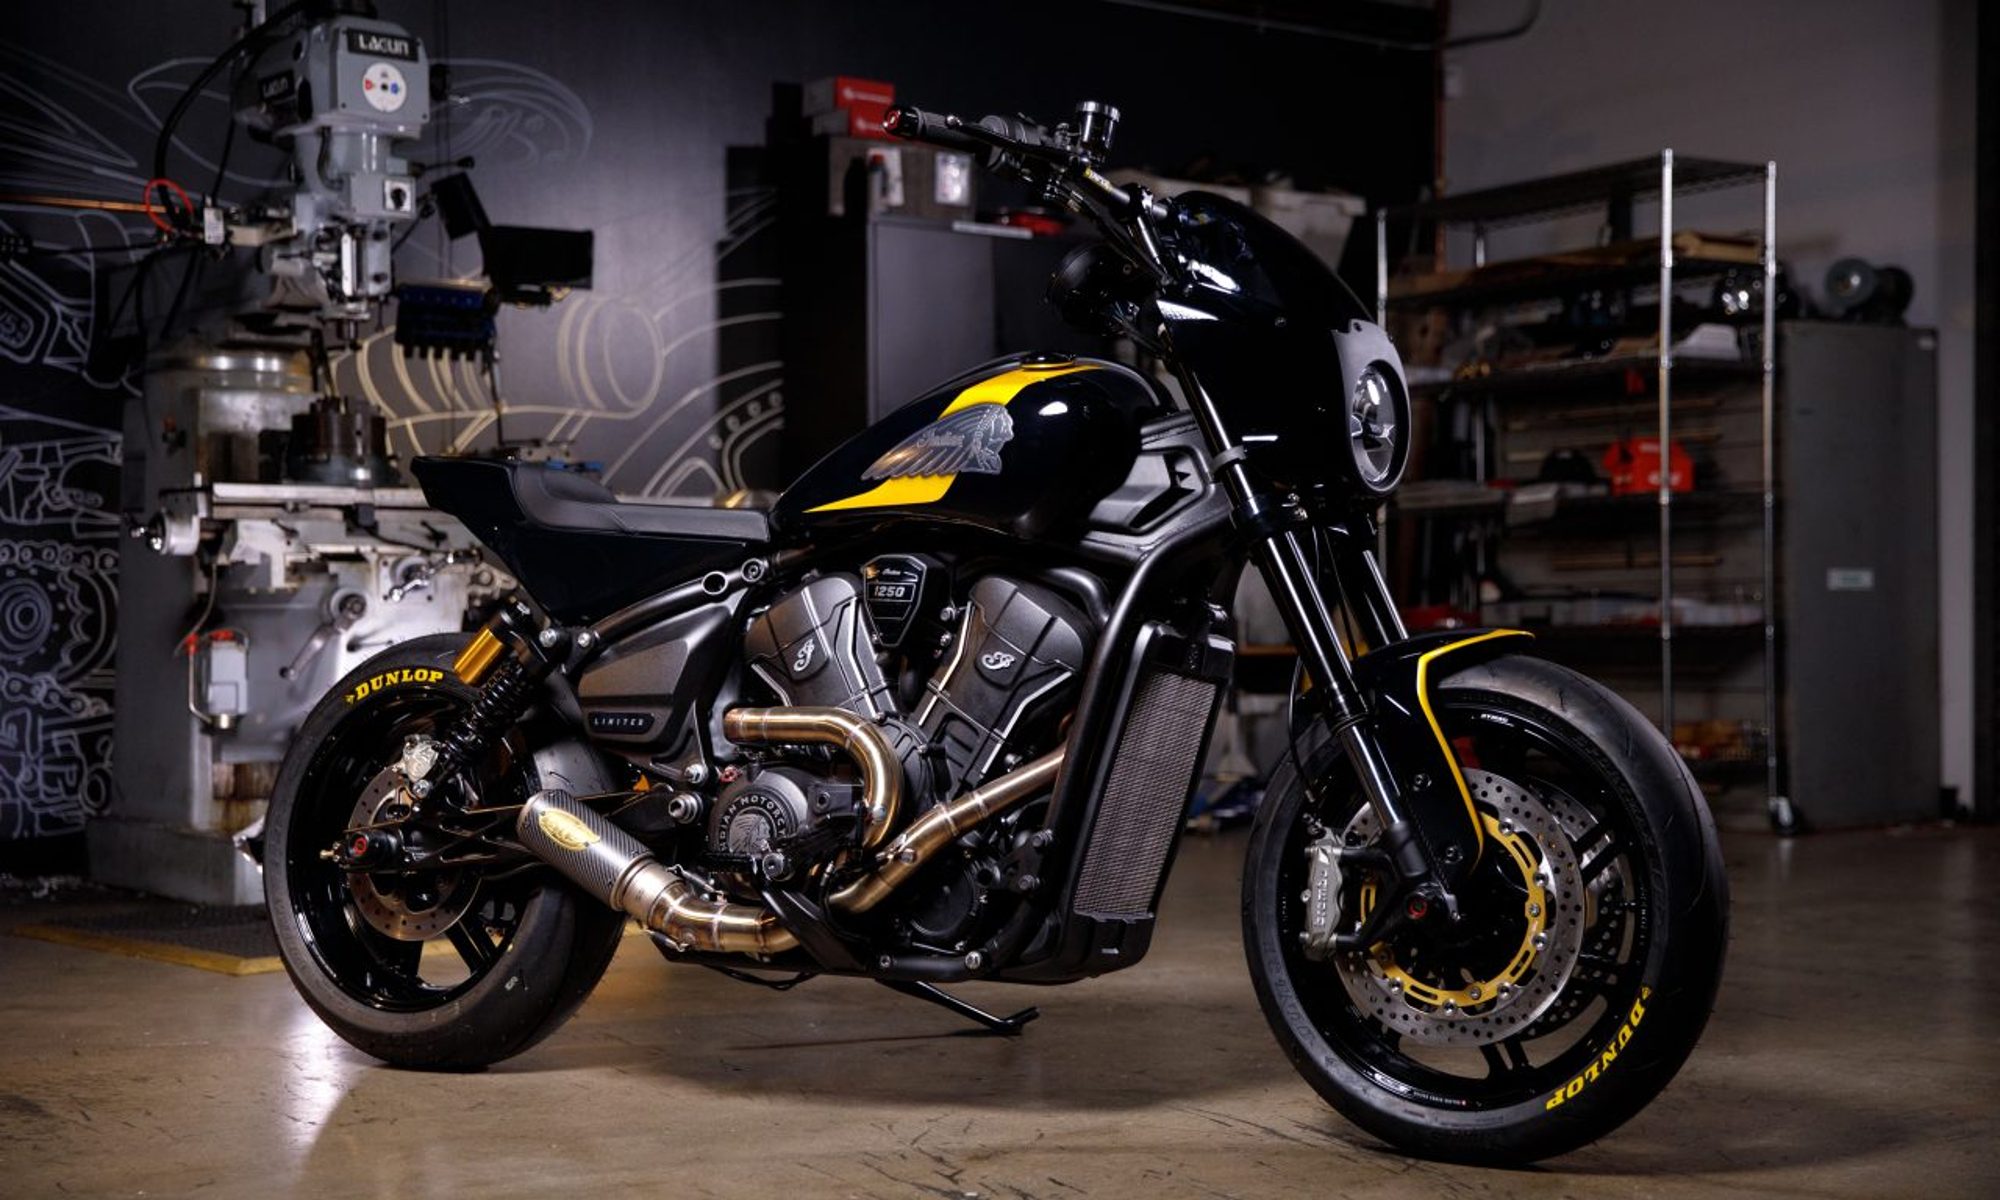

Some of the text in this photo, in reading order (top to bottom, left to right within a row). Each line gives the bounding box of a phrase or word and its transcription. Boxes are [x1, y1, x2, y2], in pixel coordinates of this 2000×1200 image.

[874, 585, 906, 598] 1250
[355, 668, 444, 701] DUNLOP
[594, 717, 644, 727] LIMITED
[719, 794, 787, 852] NDIAN MOTORCY
[1312, 869, 1328, 928] brembo
[1545, 997, 1646, 1111] DUNLOP
